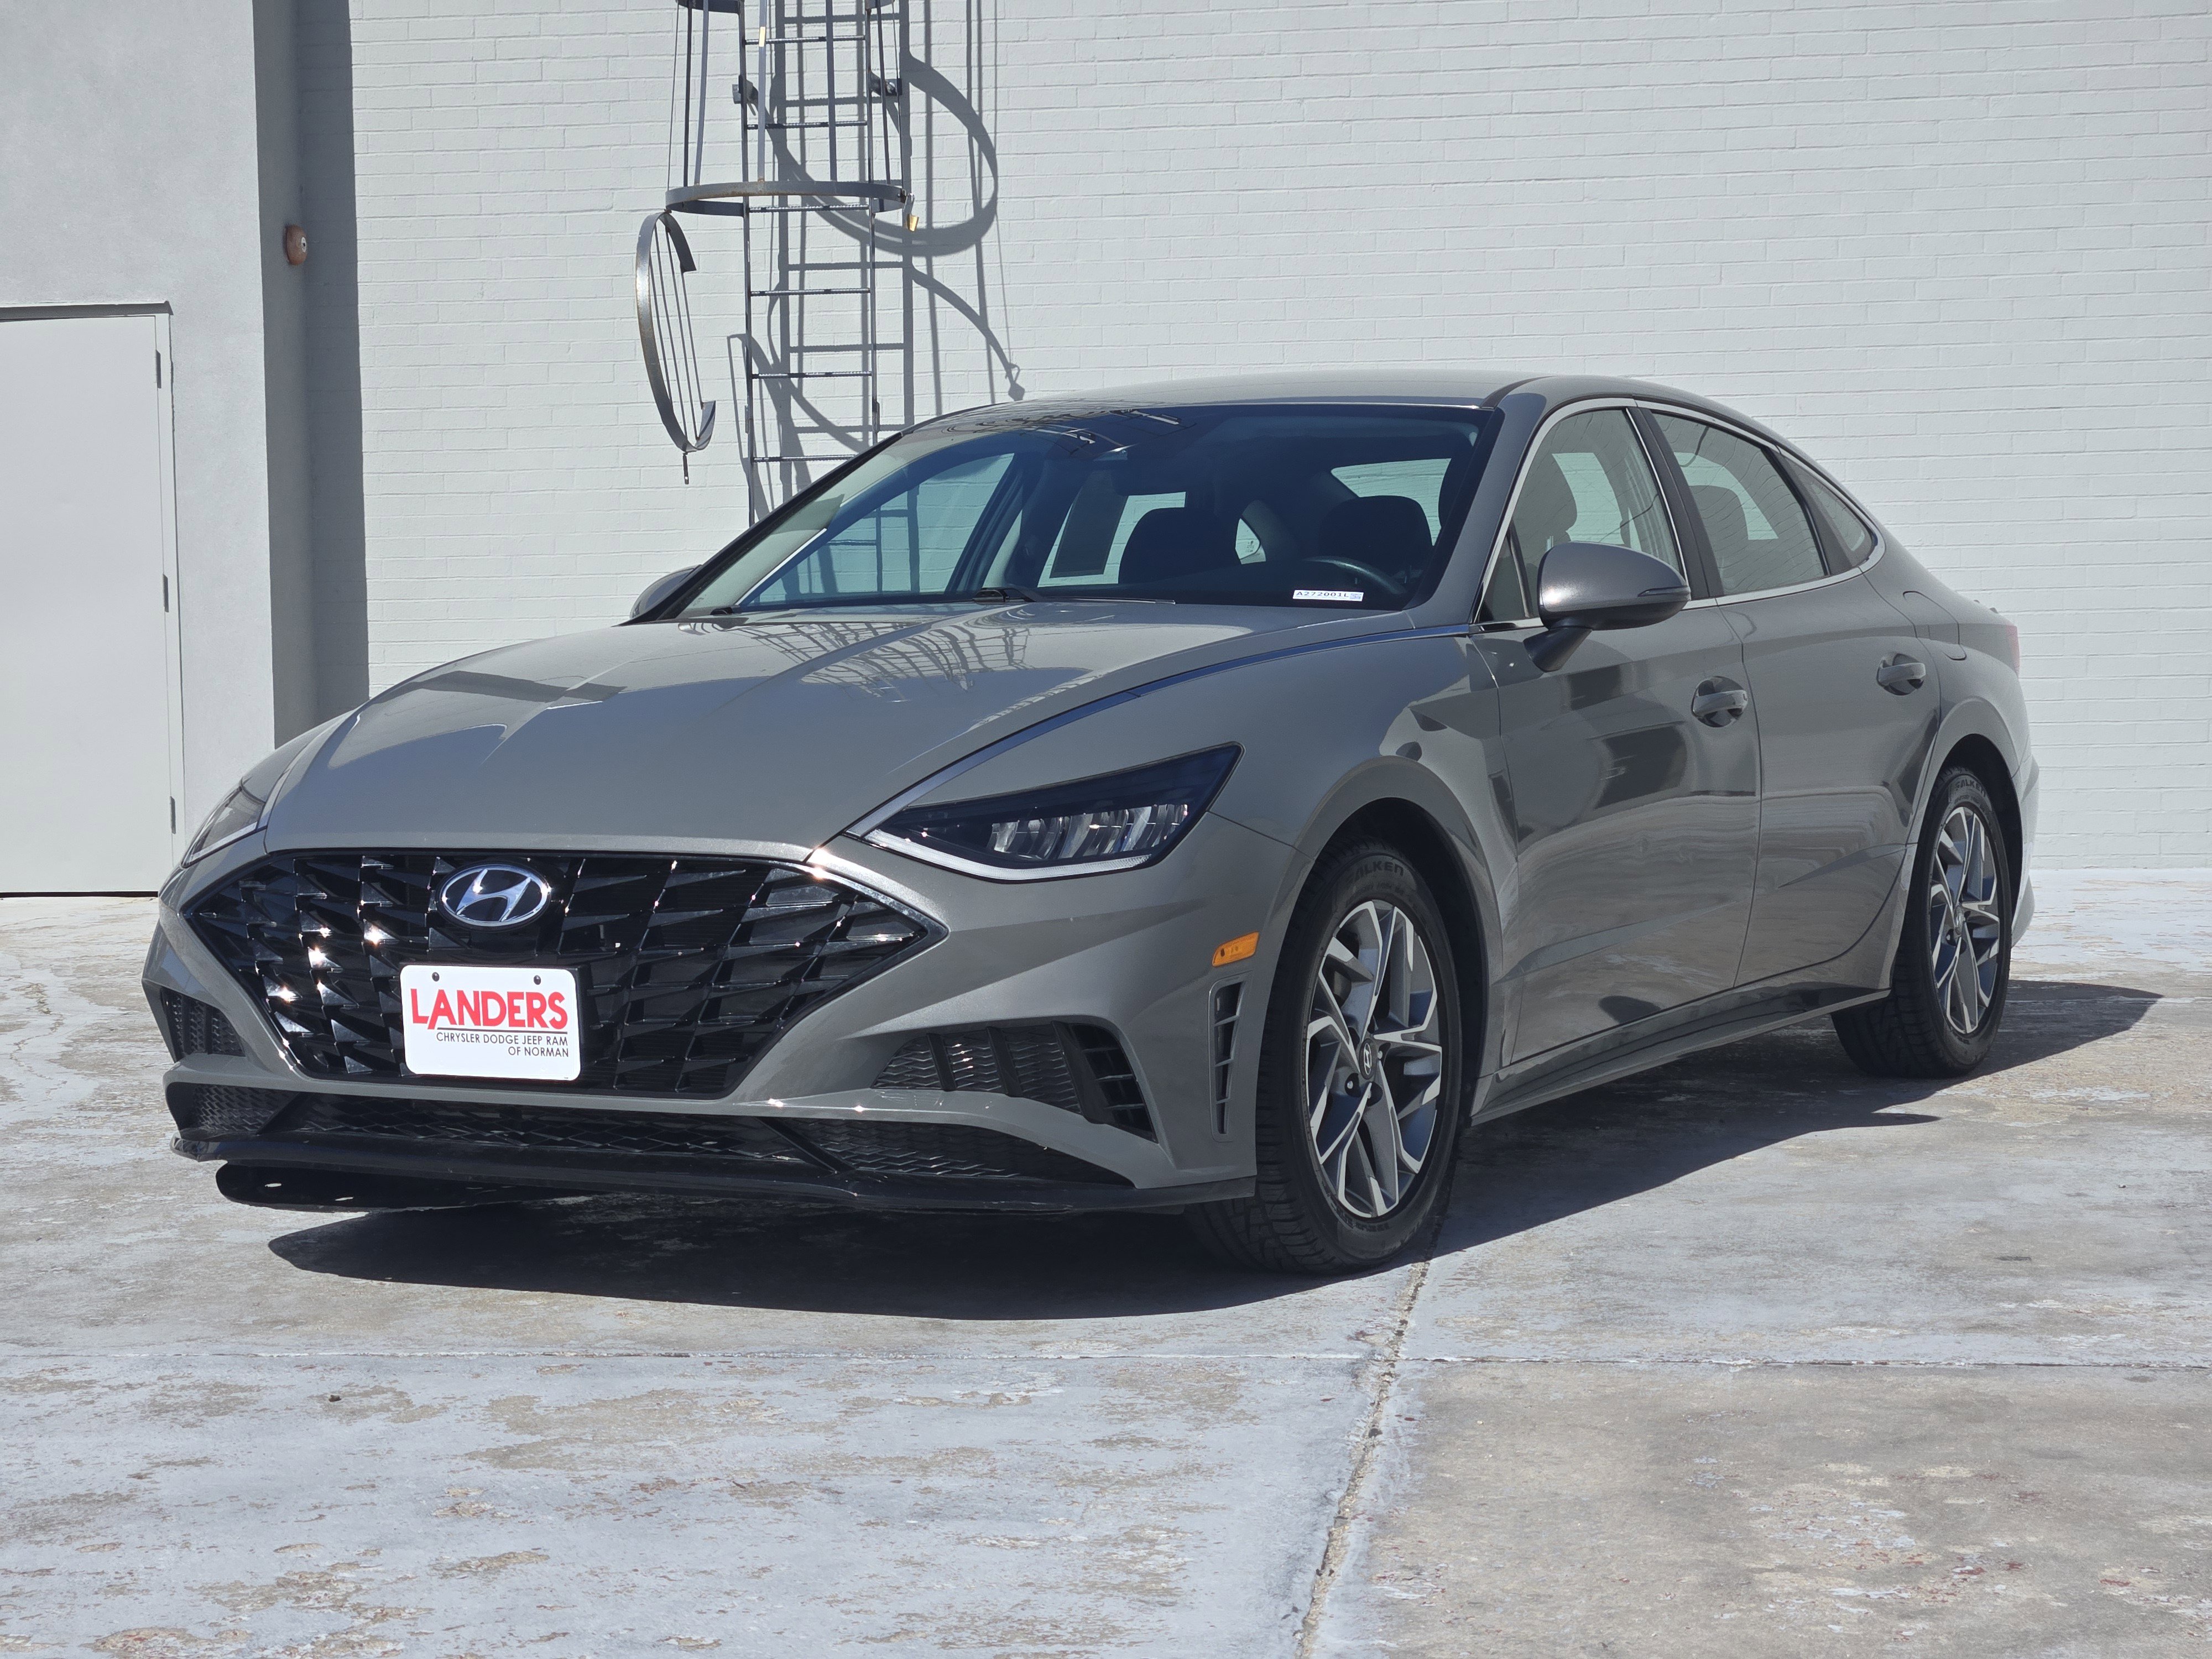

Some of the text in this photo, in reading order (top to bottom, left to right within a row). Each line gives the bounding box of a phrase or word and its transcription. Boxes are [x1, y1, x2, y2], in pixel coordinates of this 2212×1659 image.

[410, 988, 568, 1030] LANDERS
[436, 1032, 568, 1046] CHRYSLER DODGE JEEP RAM
[508, 1046, 569, 1057] OF NORMAN
